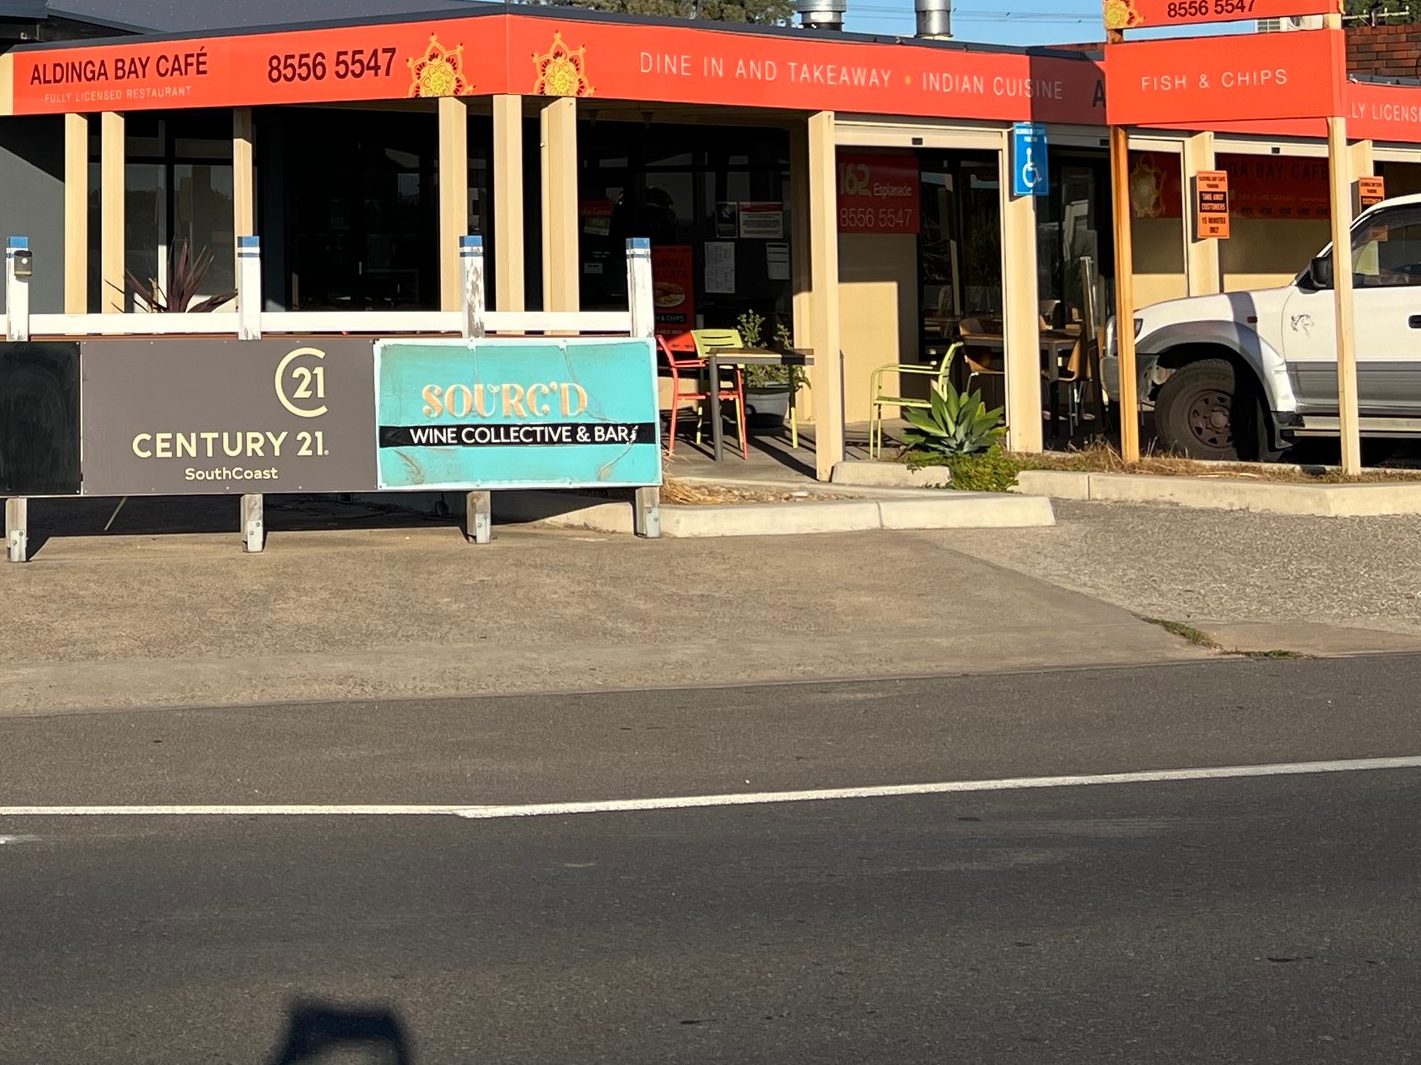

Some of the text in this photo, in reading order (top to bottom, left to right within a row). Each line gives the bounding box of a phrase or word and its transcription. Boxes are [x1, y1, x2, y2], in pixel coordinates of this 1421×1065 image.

[1167, 0, 1209, 18] 8556
[30, 46, 208, 86] ALDINGA BAY CAFÉ
[267, 47, 397, 84] 8556 5547
[640, 52, 691, 76] DINE
[704, 56, 724, 78] IN
[735, 58, 778, 81] AND
[787, 62, 892, 88] TAKEAWAY
[922, 72, 984, 95] INDIAN
[993, 76, 1064, 100] CUISINE
[1141, 68, 1288, 92] FISH & CHIPS
[44, 86, 192, 103] FULLY LICENSED RESTAURANT
[1372, 104, 1421, 123] LICENS
[838, 162, 912, 200] 162 Esplanade
[840, 208, 913, 228] 8556 5547
[422, 381, 588, 418] SOURC'D
[132, 430, 325, 458] CENTURY 21
[409, 425, 629, 445] WINE COLLECTIVE & BAR
[184, 466, 278, 481] SouthCoast
